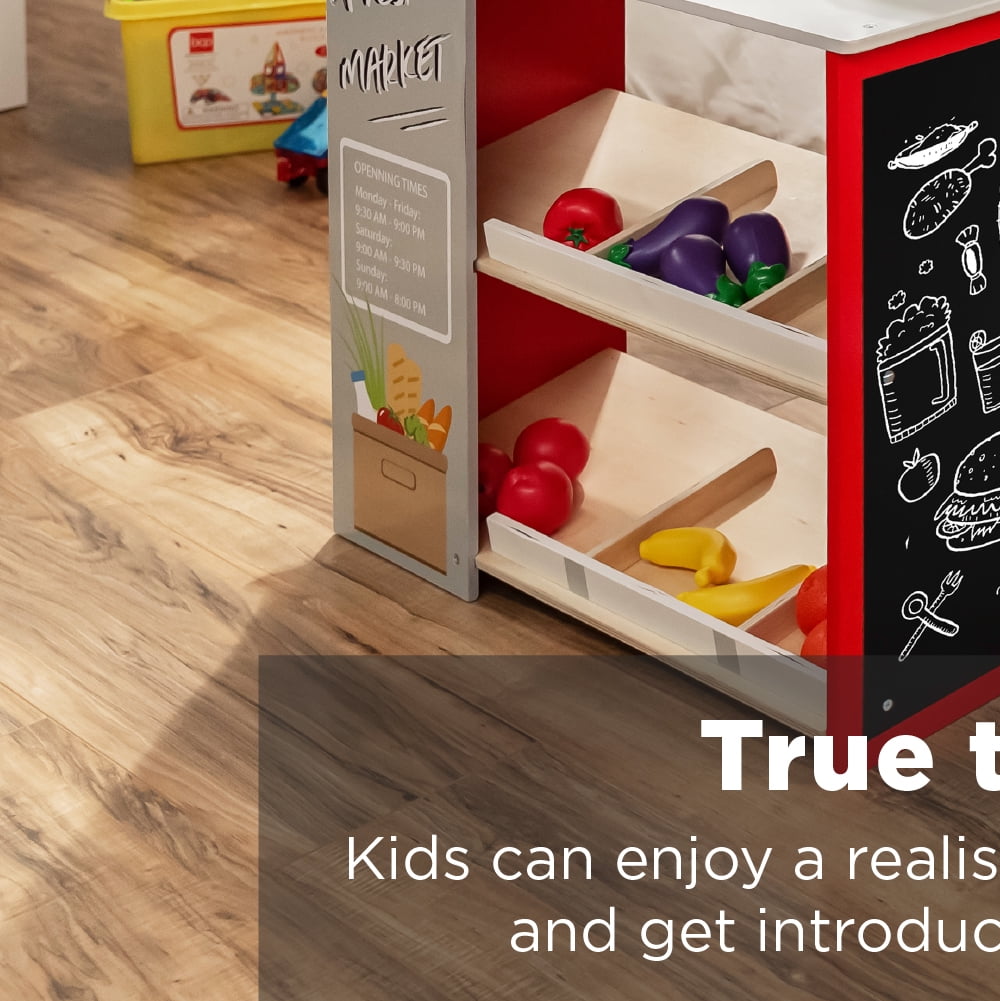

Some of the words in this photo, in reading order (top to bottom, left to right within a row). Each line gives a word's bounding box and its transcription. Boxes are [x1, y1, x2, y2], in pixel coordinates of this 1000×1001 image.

[338, 32, 453, 95] MARKET
[353, 160, 400, 188] OPENNING
[401, 177, 428, 199] TIMES
[355, 184, 387, 210] Monday
[355, 203, 372, 220] 9:30
[373, 210, 387, 225] AM
[393, 218, 411, 235] 9:00
[412, 225, 425, 241] PM
[373, 248, 388, 264] AM
[412, 263, 426, 279] PM
[374, 284, 388, 301] AM
[413, 301, 426, 317] PM
